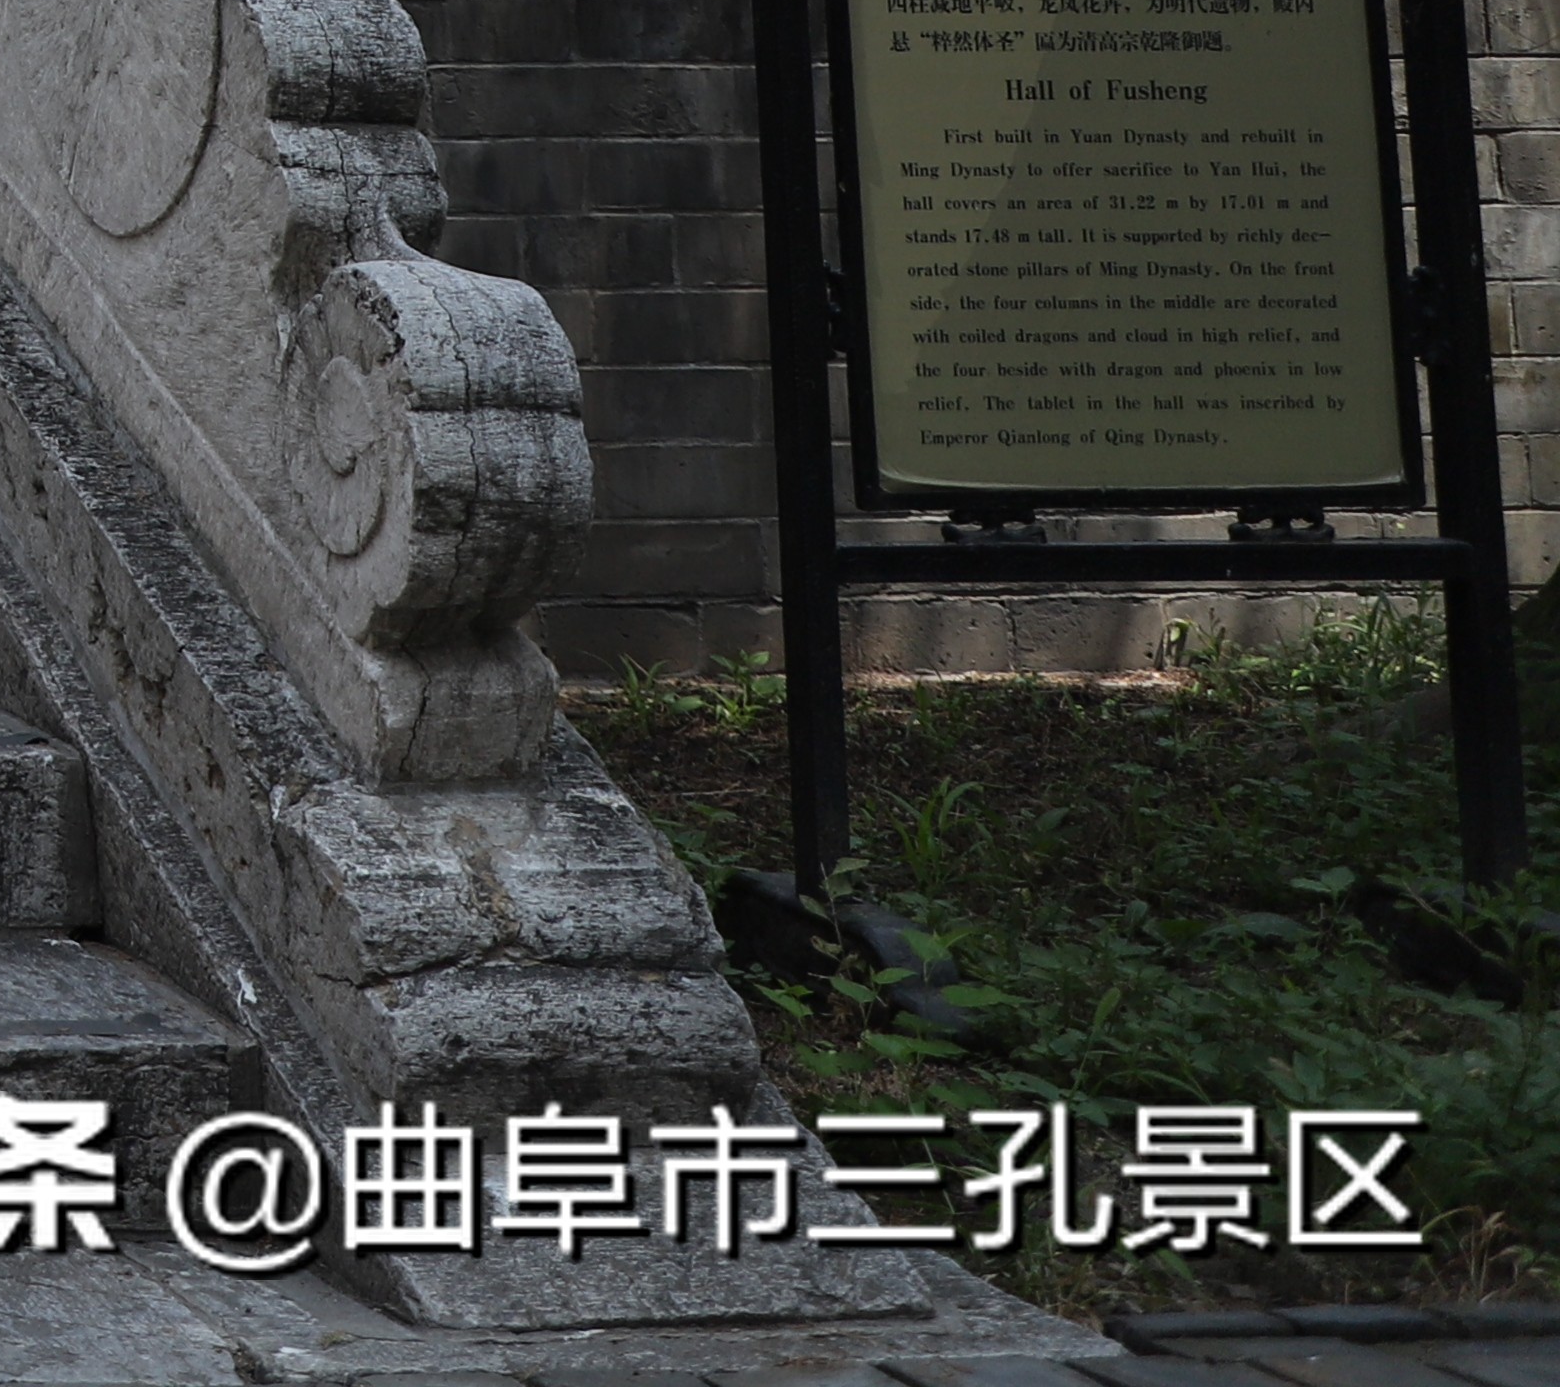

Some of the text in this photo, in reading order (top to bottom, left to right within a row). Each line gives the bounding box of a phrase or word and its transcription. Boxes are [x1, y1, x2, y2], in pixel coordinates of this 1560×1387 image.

[1004, 78, 1209, 105] Hall of Fusheng
[943, 127, 1324, 147] First built in Yuan Dynasty and rebuilt in
[899, 160, 1326, 181] Ming Dynasty to offer sacrifice to Yan Hui, the
[902, 194, 1330, 213] hall covers an area of 31.22 m by 17.01 m and
[904, 226, 1332, 246] stands 17.48 m tall. It is supported by richly dec-
[906, 260, 1335, 281] orated stone pillars of Ming Dynasty. On the front
[909, 293, 1338, 313] side, the four columns in the middle are decorated
[911, 326, 1341, 347] with coiled dragons and cloud in high relief, and
[914, 360, 1343, 380] the four beside with dragon and phoenix in low
[917, 393, 1346, 413] relief. The tablet in the hall was inscribed by
[919, 428, 1228, 449] Emperor Qianlong of Qing Dynasty.
